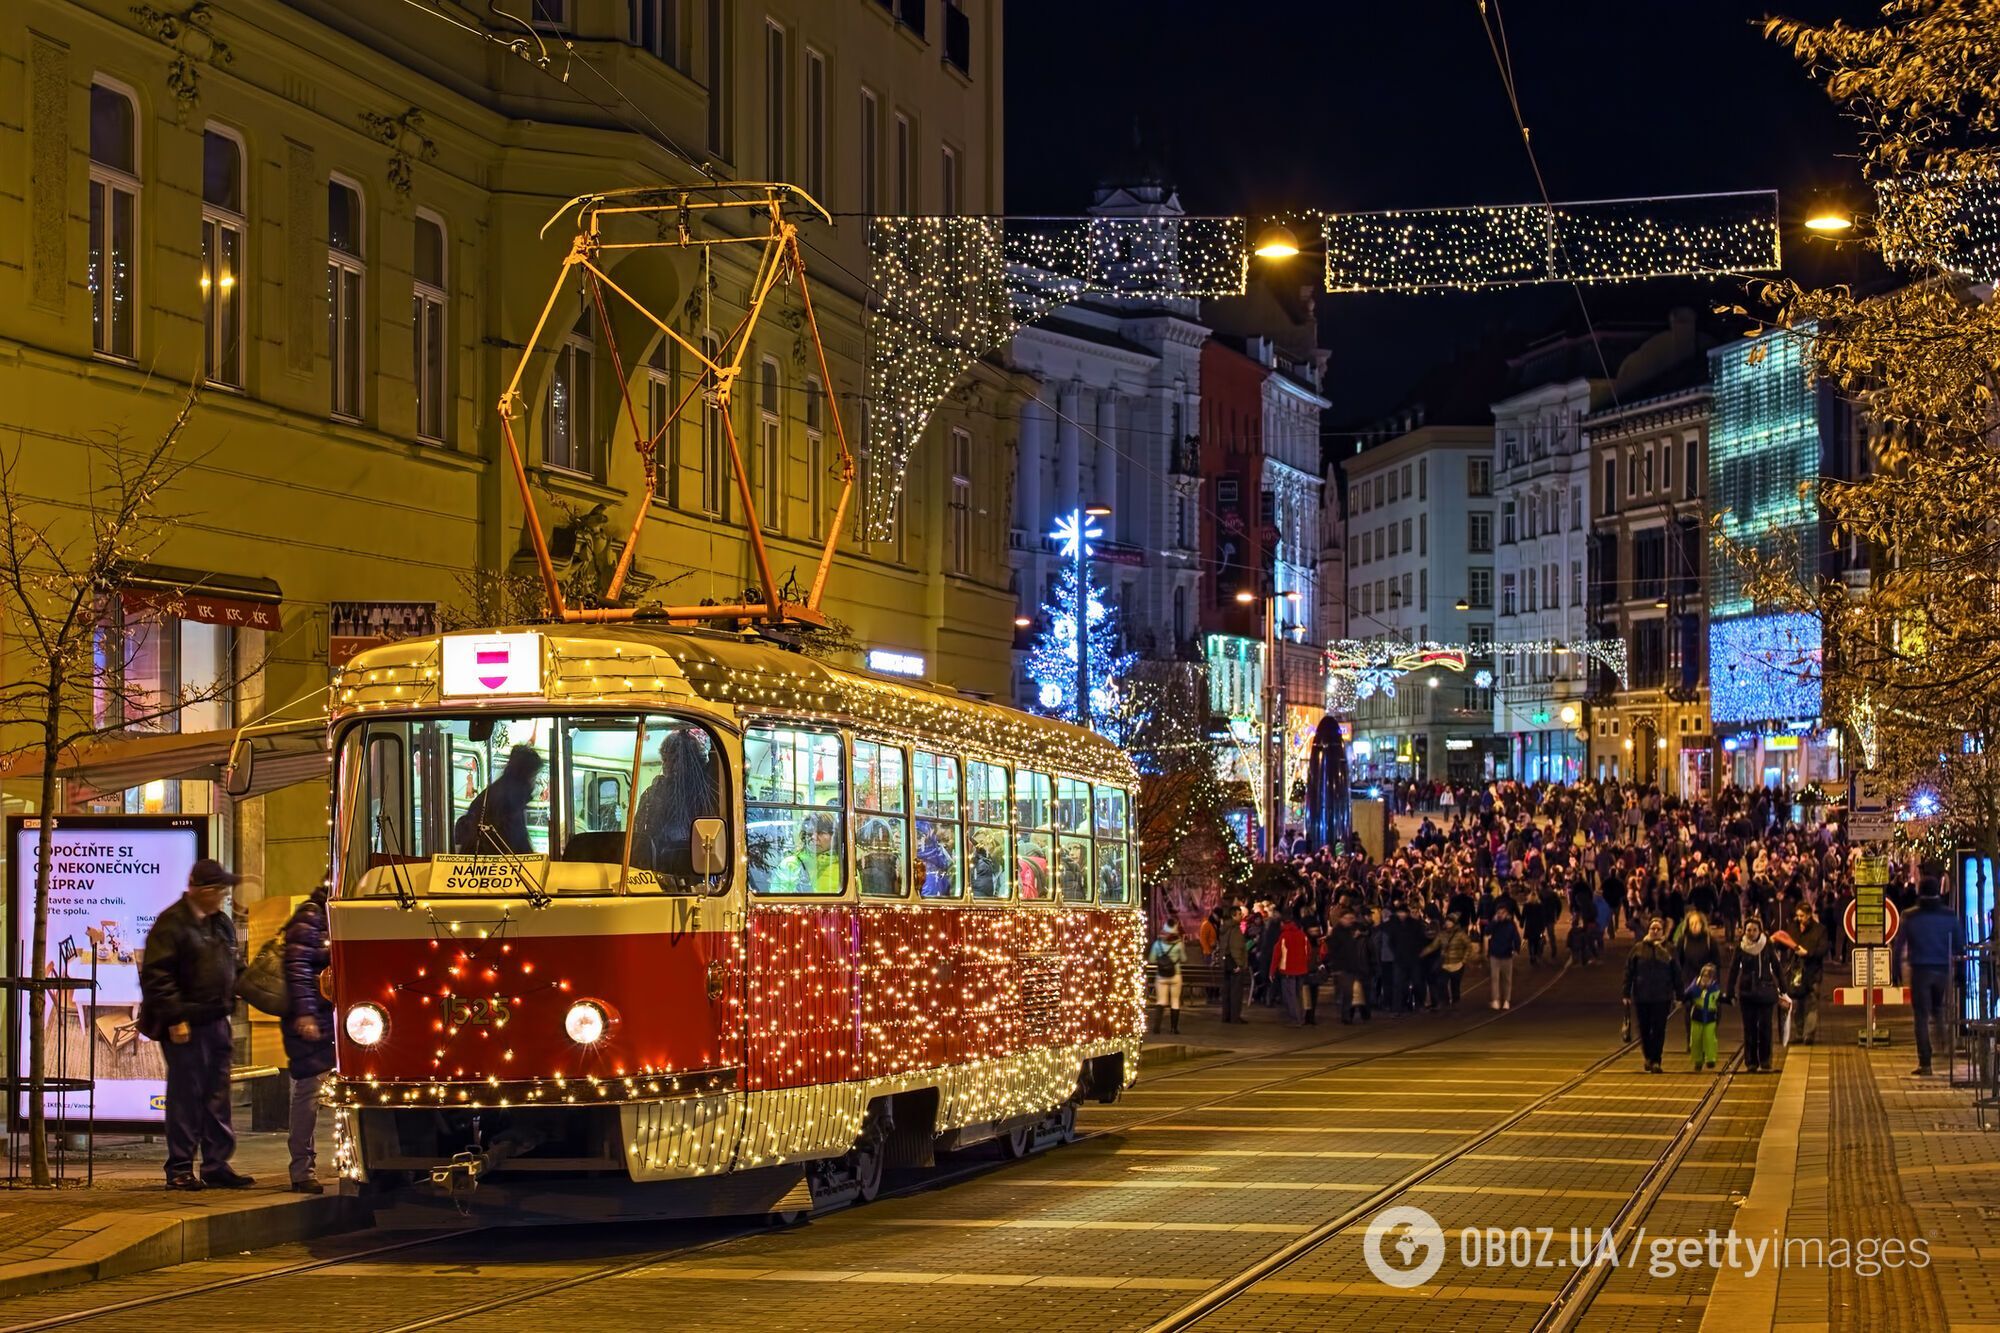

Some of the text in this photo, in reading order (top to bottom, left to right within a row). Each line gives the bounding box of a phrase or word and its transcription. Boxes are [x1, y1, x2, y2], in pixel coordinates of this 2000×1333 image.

[198, 605, 214, 618] KFC
[225, 608, 243, 621] KFC
[252, 611, 269, 624] KFC
[119, 846, 133, 857] SI
[58, 859, 160, 874] NEKONEČNÝCH
[447, 877, 520, 889] SVOBODY
[63, 907, 90, 916] spolu.
[440, 997, 511, 1026] 1525
